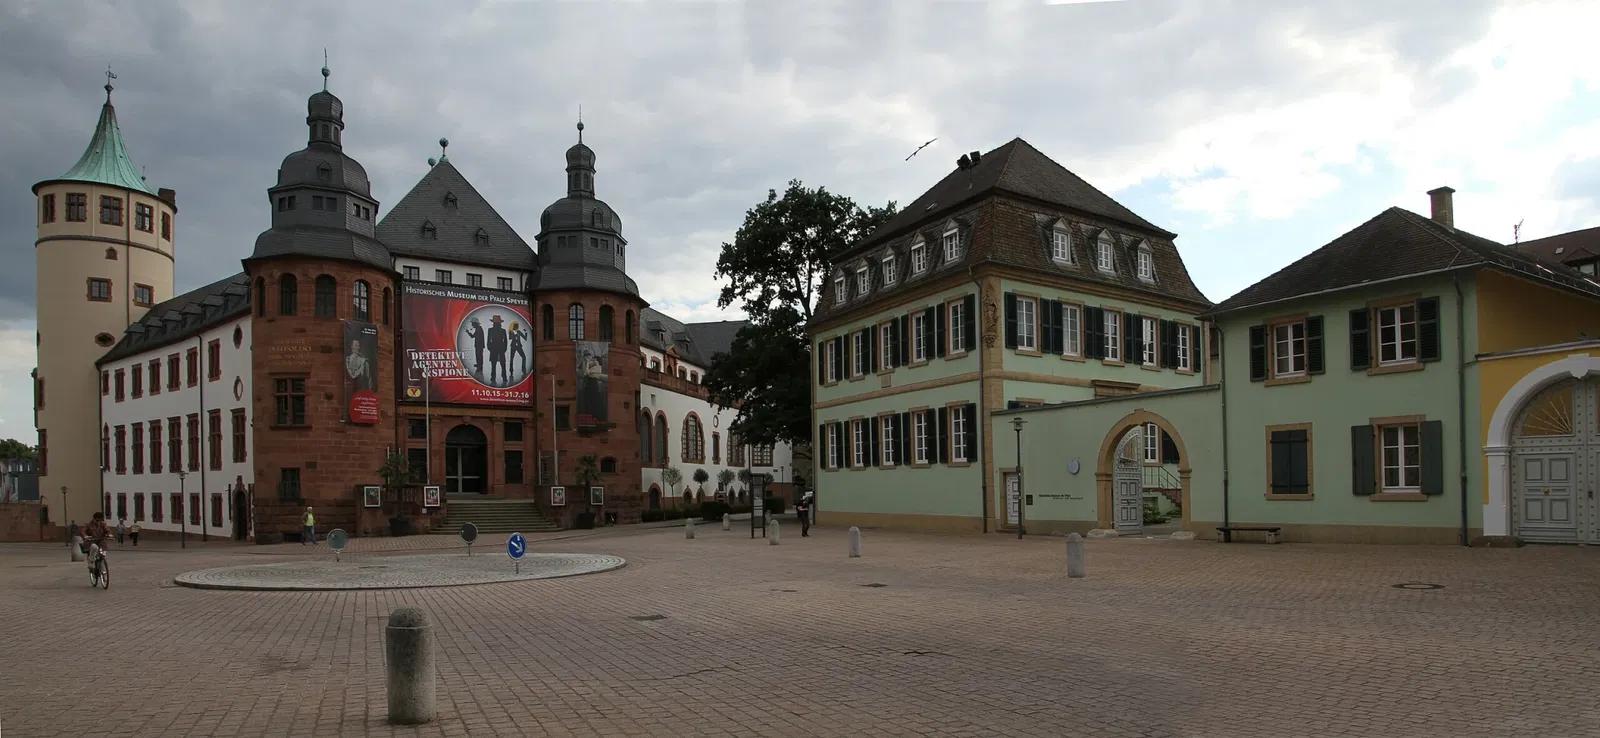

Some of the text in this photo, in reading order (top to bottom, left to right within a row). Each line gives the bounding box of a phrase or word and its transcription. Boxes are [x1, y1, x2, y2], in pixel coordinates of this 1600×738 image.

[405, 286, 446, 297] HISTORISCHES
[446, 291, 477, 300] MUSEUM
[489, 294, 505, 303] PFALZ
[506, 297, 528, 305] SPEYER
[412, 360, 458, 369] AGENTEN
